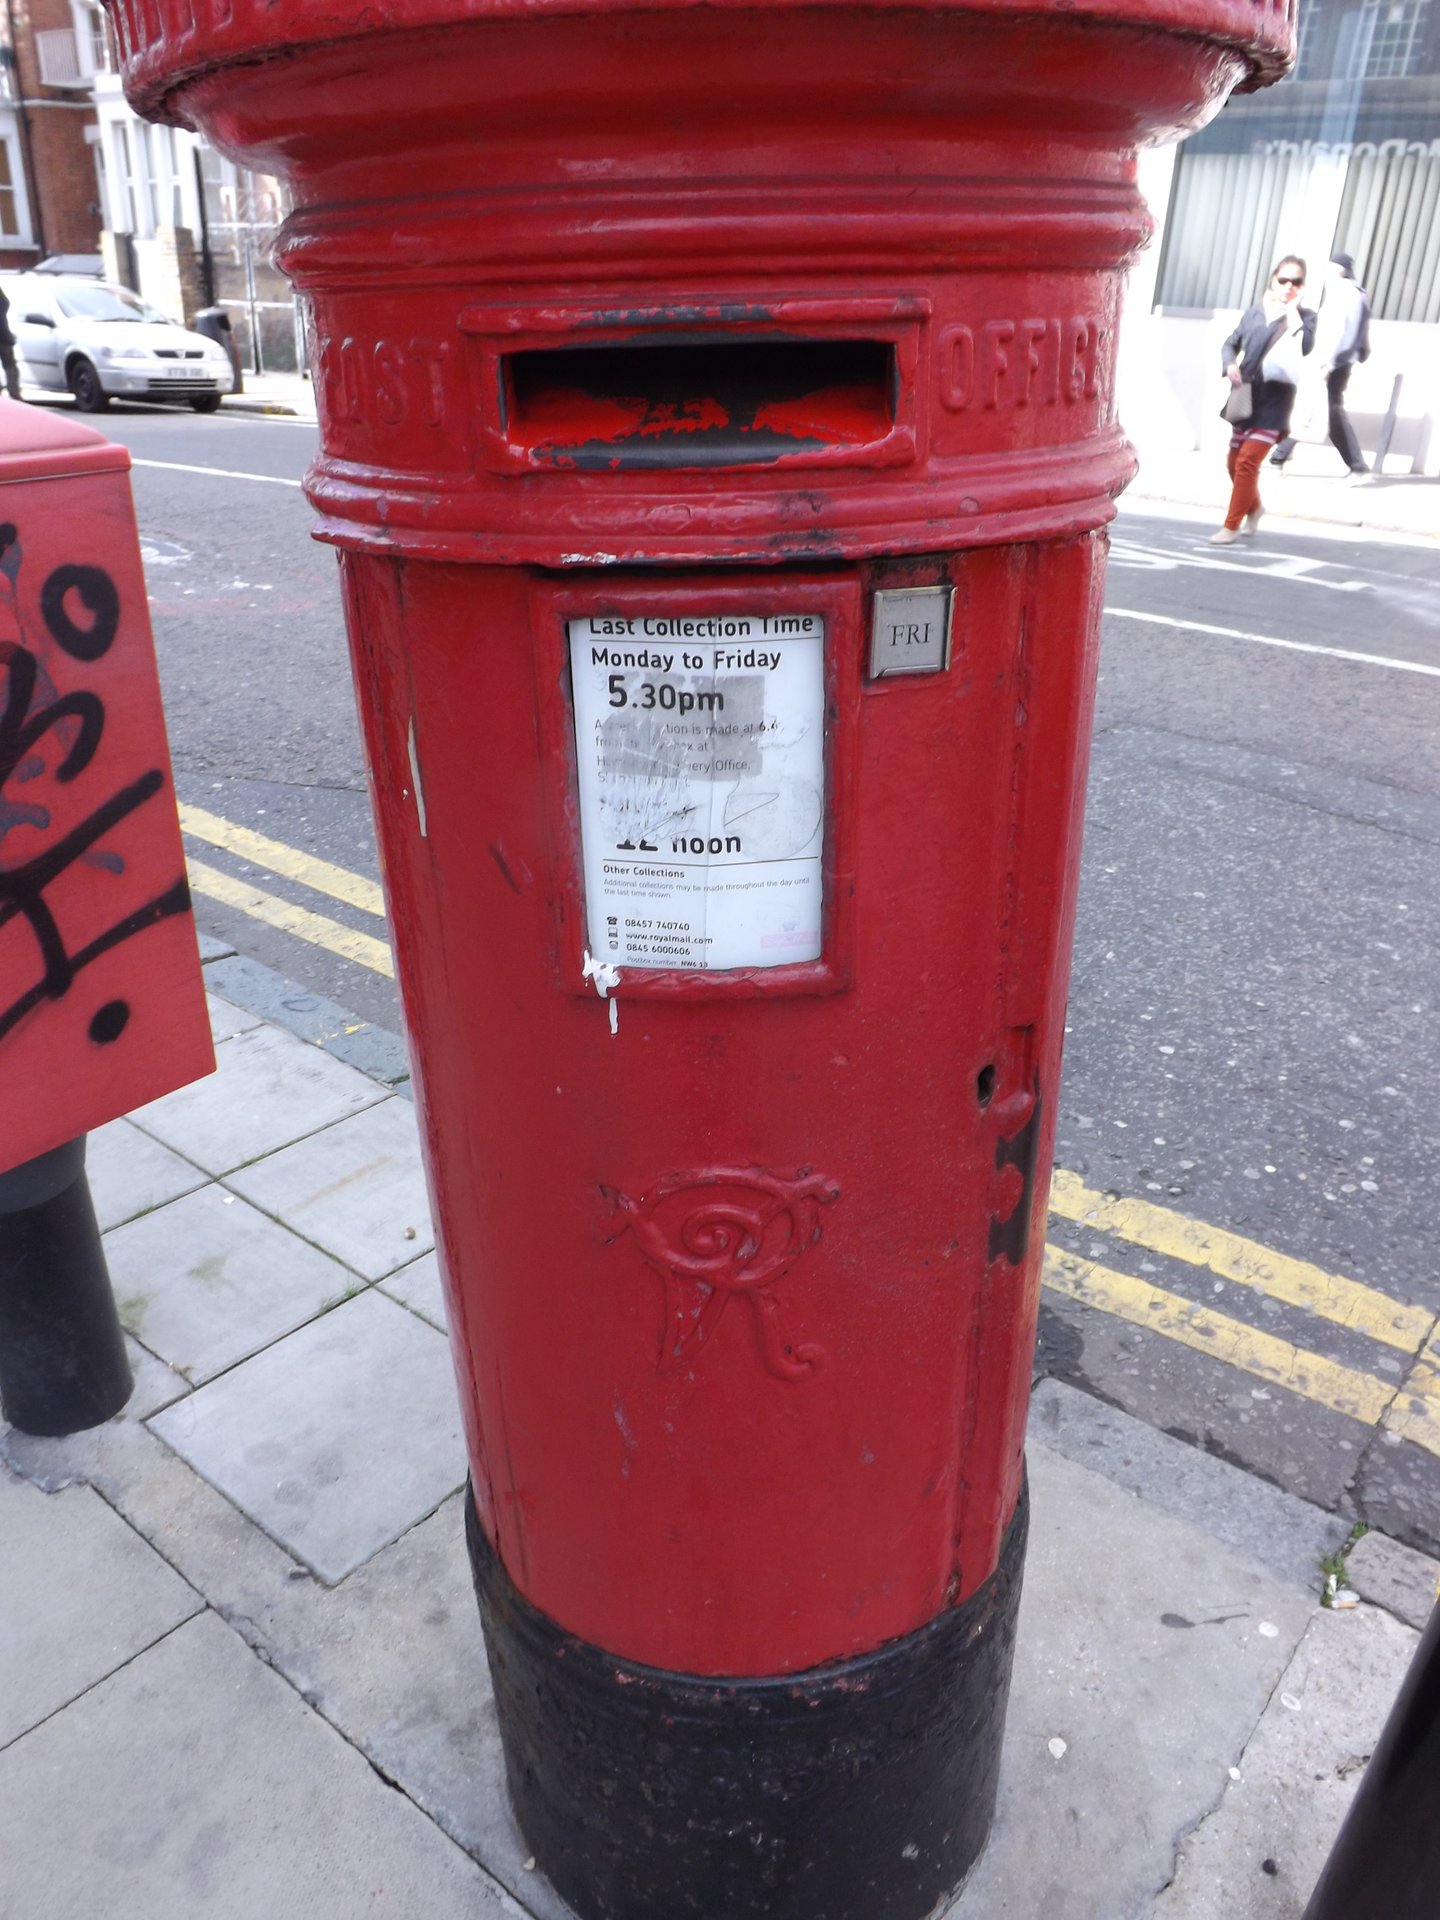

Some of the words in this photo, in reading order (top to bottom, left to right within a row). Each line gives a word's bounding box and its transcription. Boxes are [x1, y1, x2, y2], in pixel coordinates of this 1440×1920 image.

[589, 618, 635, 635] Last
[643, 617, 751, 638] Collection
[760, 616, 814, 635] Time
[890, 622, 932, 647] FRI
[591, 647, 674, 672] Monday
[682, 652, 704, 669] to
[713, 650, 782, 671] Friday
[608, 674, 725, 716] 5.30pm
[691, 723, 702, 734] is
[705, 722, 739, 735] made
[743, 722, 755, 734] at
[697, 741, 709, 752] at
[670, 836, 742, 855] noon
[603, 864, 630, 875] Other
[633, 866, 685, 878] Collections
[603, 878, 637, 888] Additional
[638, 882, 674, 891] collections
[703, 883, 724, 892] made
[726, 881, 765, 890] throughout
[767, 880, 779, 888] the
[780, 879, 793, 888] day
[794, 877, 811, 886] until
[630, 889, 647, 898] time
[625, 918, 653, 928] 08457
[656, 921, 690, 931] 740740
[625, 932, 713, 945] www.royalmail.com
[626, 943, 648, 952] 0845
[651, 945, 691, 955] 6000606
[652, 958, 677, 966] number
